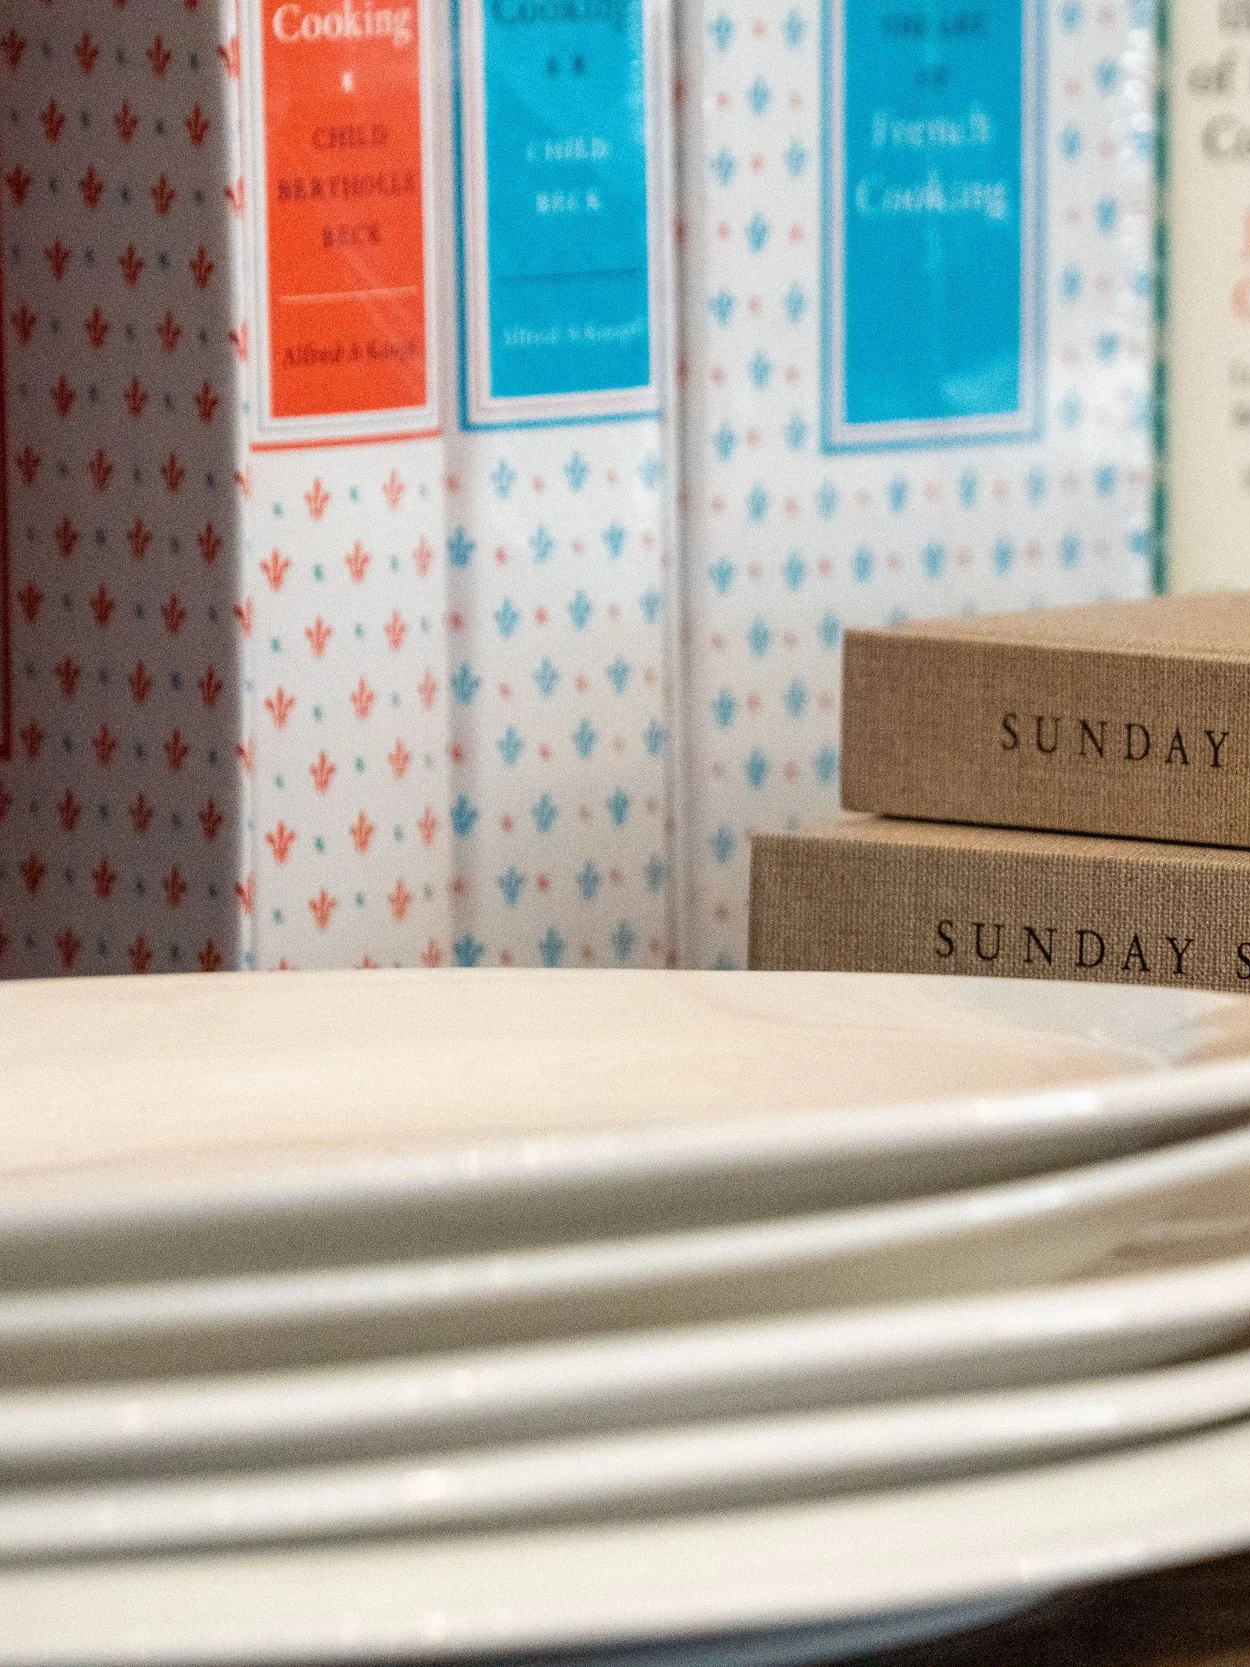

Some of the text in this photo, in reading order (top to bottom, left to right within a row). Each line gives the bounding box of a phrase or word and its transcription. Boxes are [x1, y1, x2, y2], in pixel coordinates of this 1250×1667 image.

[272, 1, 414, 47] Cooking
[312, 123, 389, 151] CHILD
[525, 138, 610, 162] CHILD
[535, 193, 601, 215] BECK
[1001, 711, 1231, 769] SUNDAY
[934, 918, 1196, 975] SUNDAY
